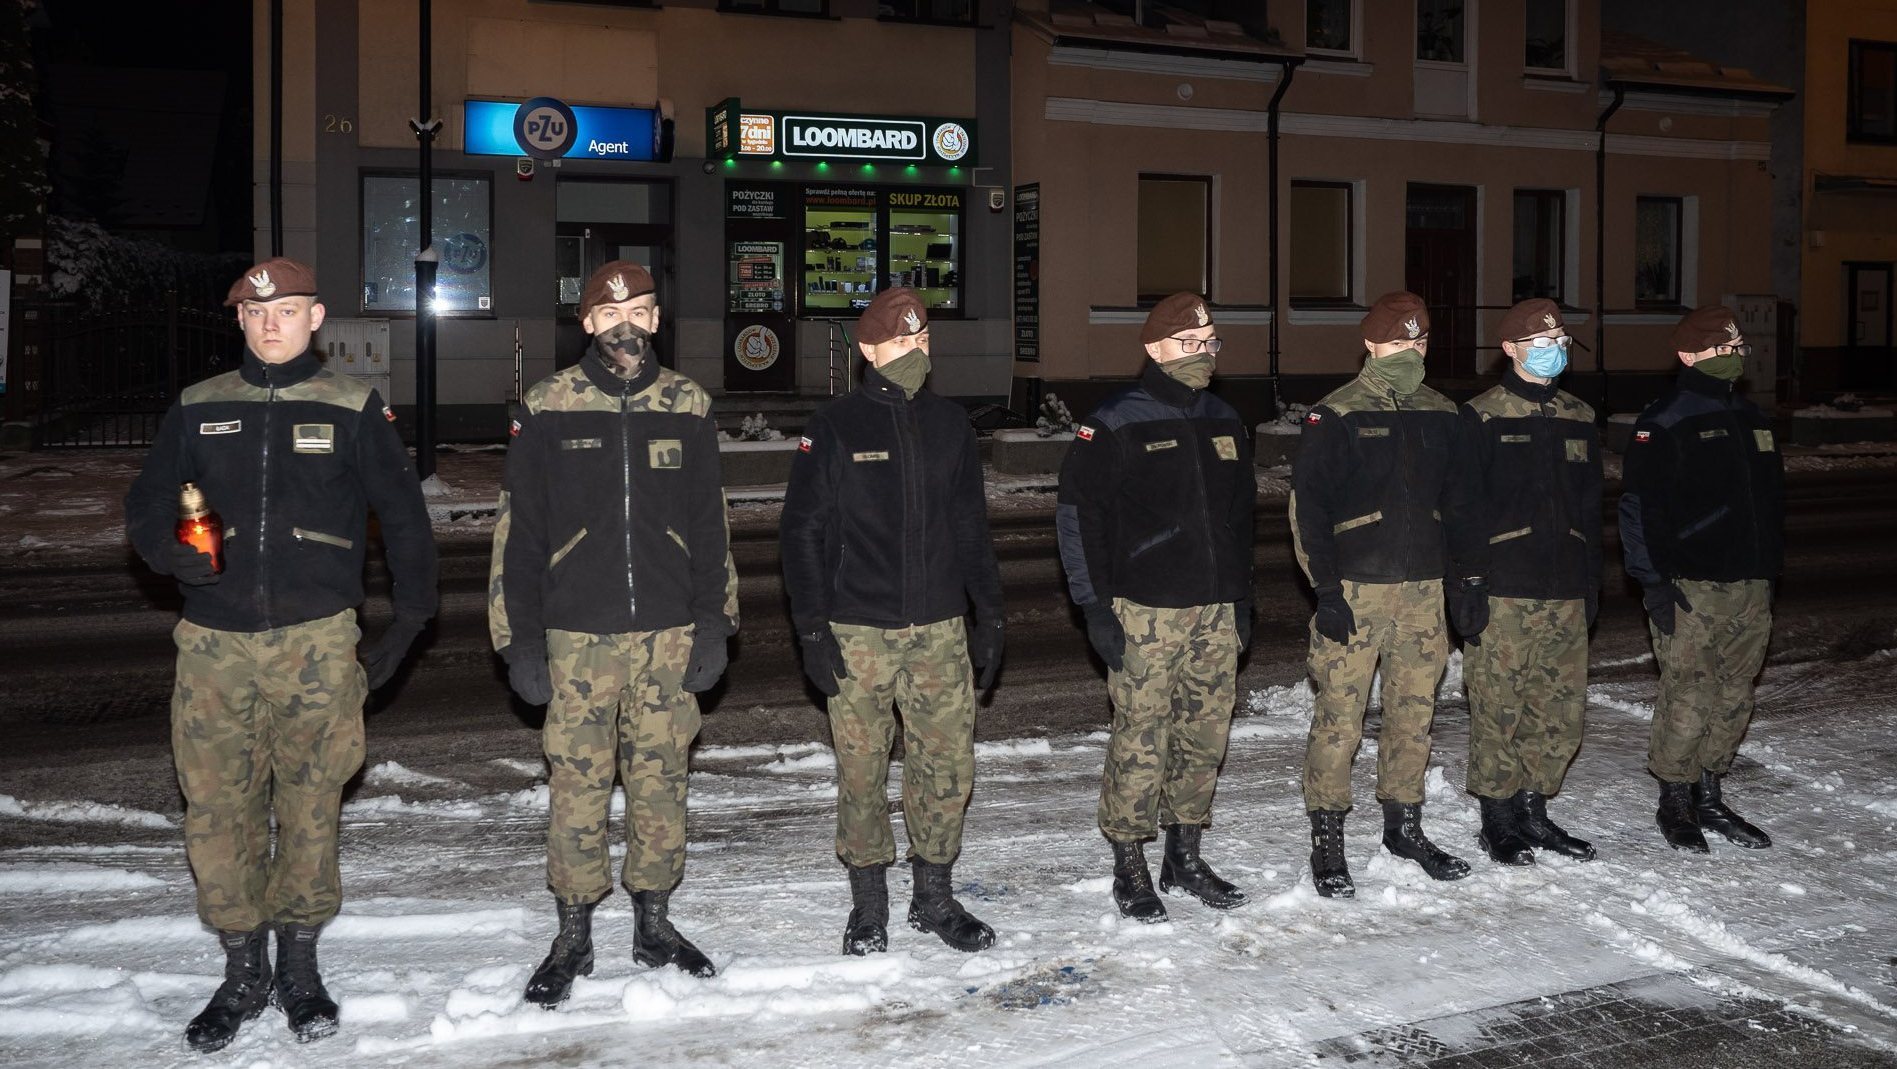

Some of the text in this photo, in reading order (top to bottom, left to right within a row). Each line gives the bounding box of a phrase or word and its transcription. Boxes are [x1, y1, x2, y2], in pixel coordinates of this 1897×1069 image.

[325, 115, 352, 134] 26
[528, 115, 564, 142] PZU
[793, 126, 917, 150] LOOMBARD
[588, 139, 629, 155] Agent
[732, 190, 774, 200] POŻYCZKI
[889, 193, 960, 207] SKUP ZŁOTA
